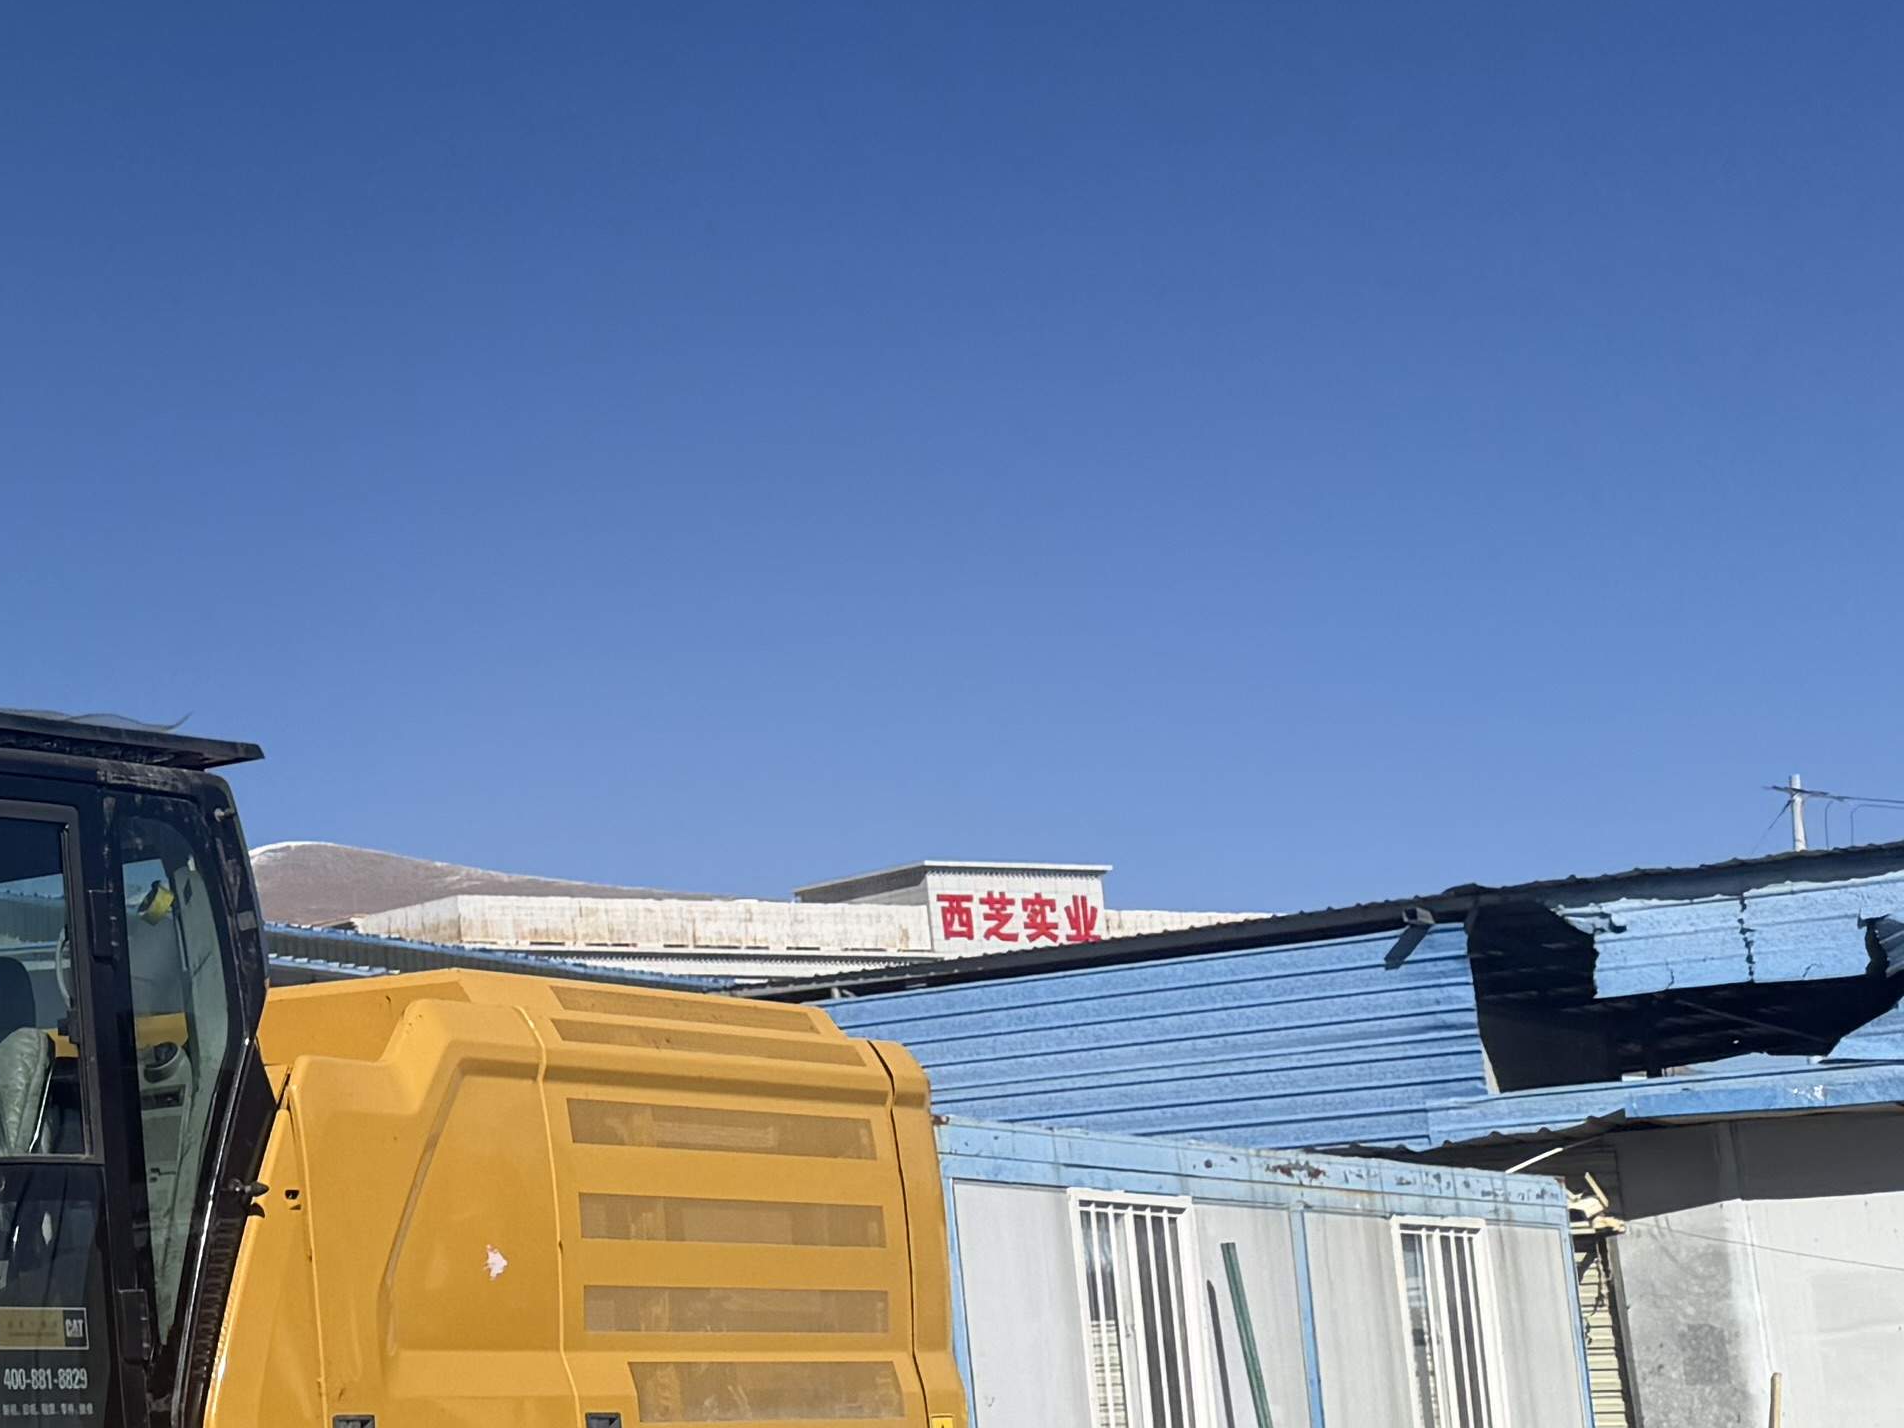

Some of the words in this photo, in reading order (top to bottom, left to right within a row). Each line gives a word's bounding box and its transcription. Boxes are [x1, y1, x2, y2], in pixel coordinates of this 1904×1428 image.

[936, 891, 1102, 943] 西芝实业
[65, 1319, 83, 1338] CAT
